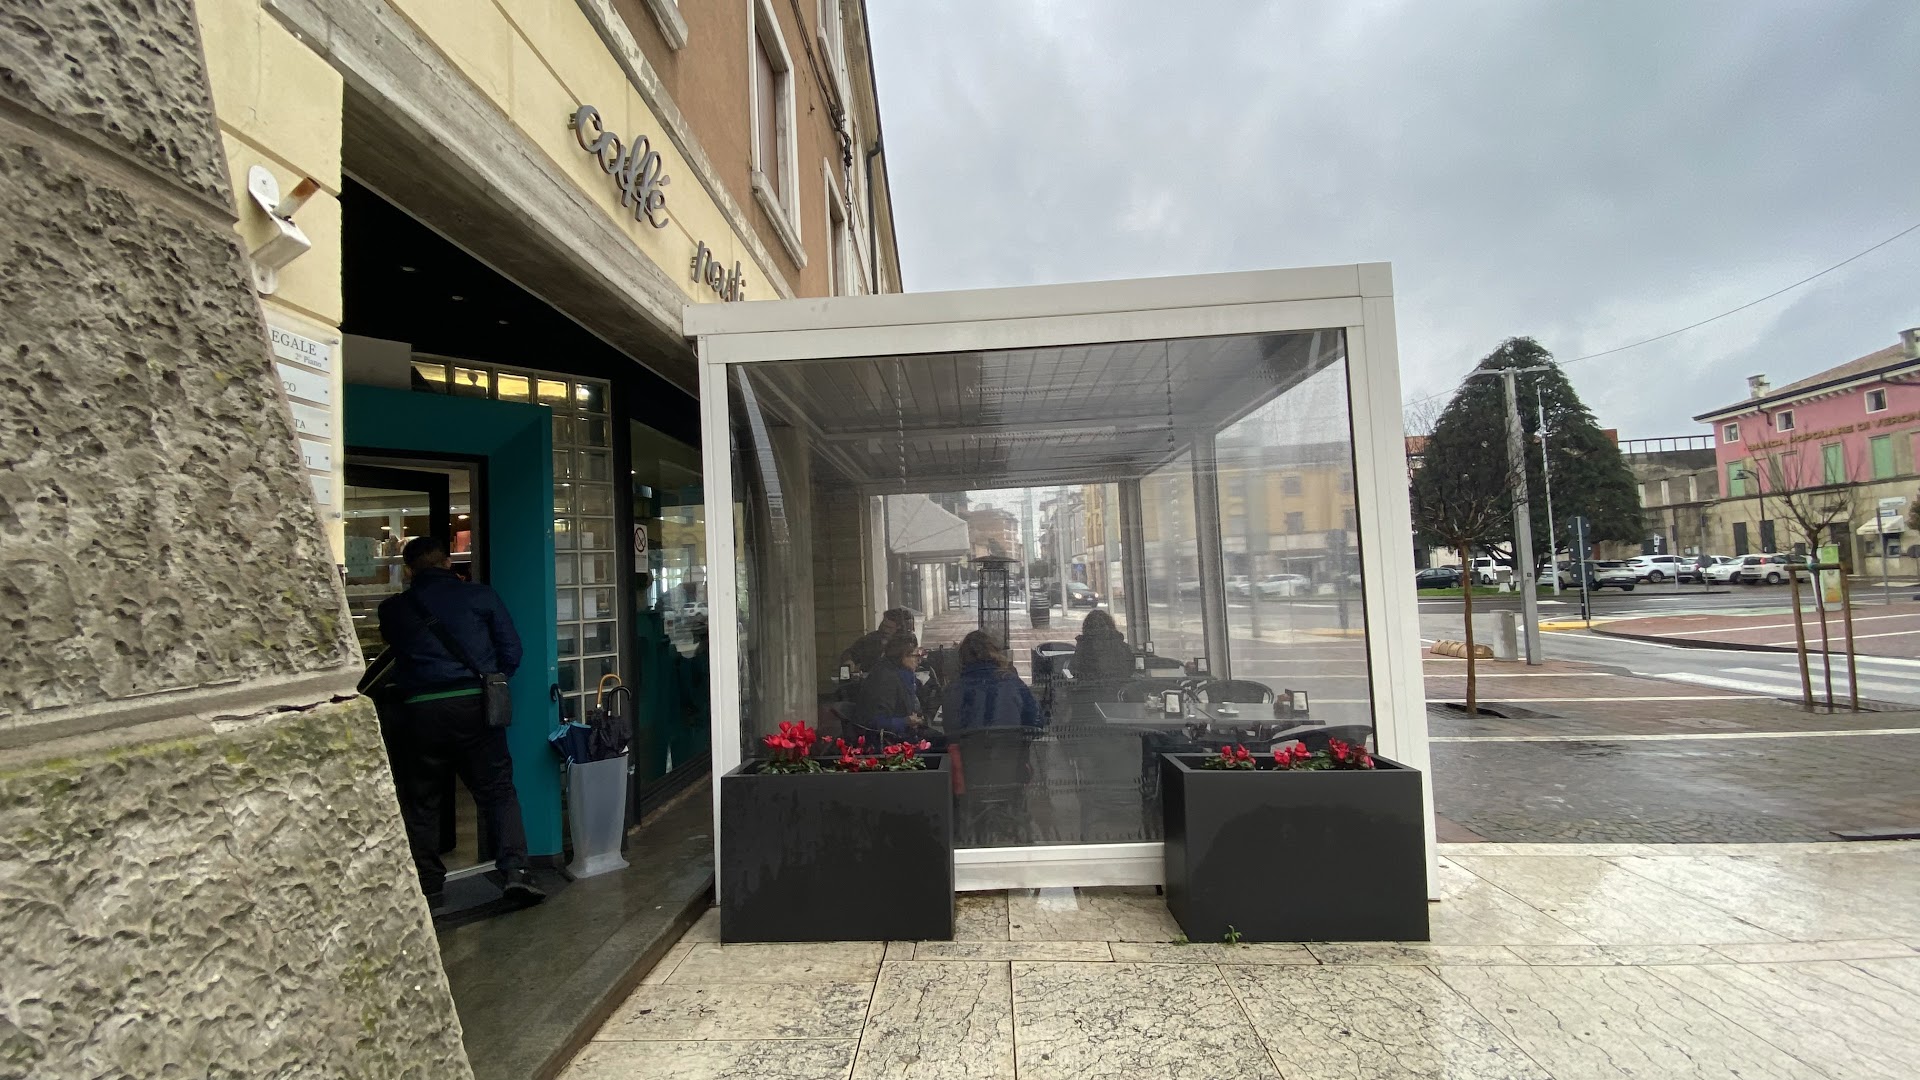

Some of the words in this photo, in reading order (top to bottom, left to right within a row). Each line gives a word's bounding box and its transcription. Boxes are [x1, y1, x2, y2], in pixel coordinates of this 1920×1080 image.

[271, 329, 317, 356] EGALE
[303, 356, 322, 368] Piano
[1790, 425, 1854, 444] POPOLARE
[1857, 421, 1871, 432] DI
